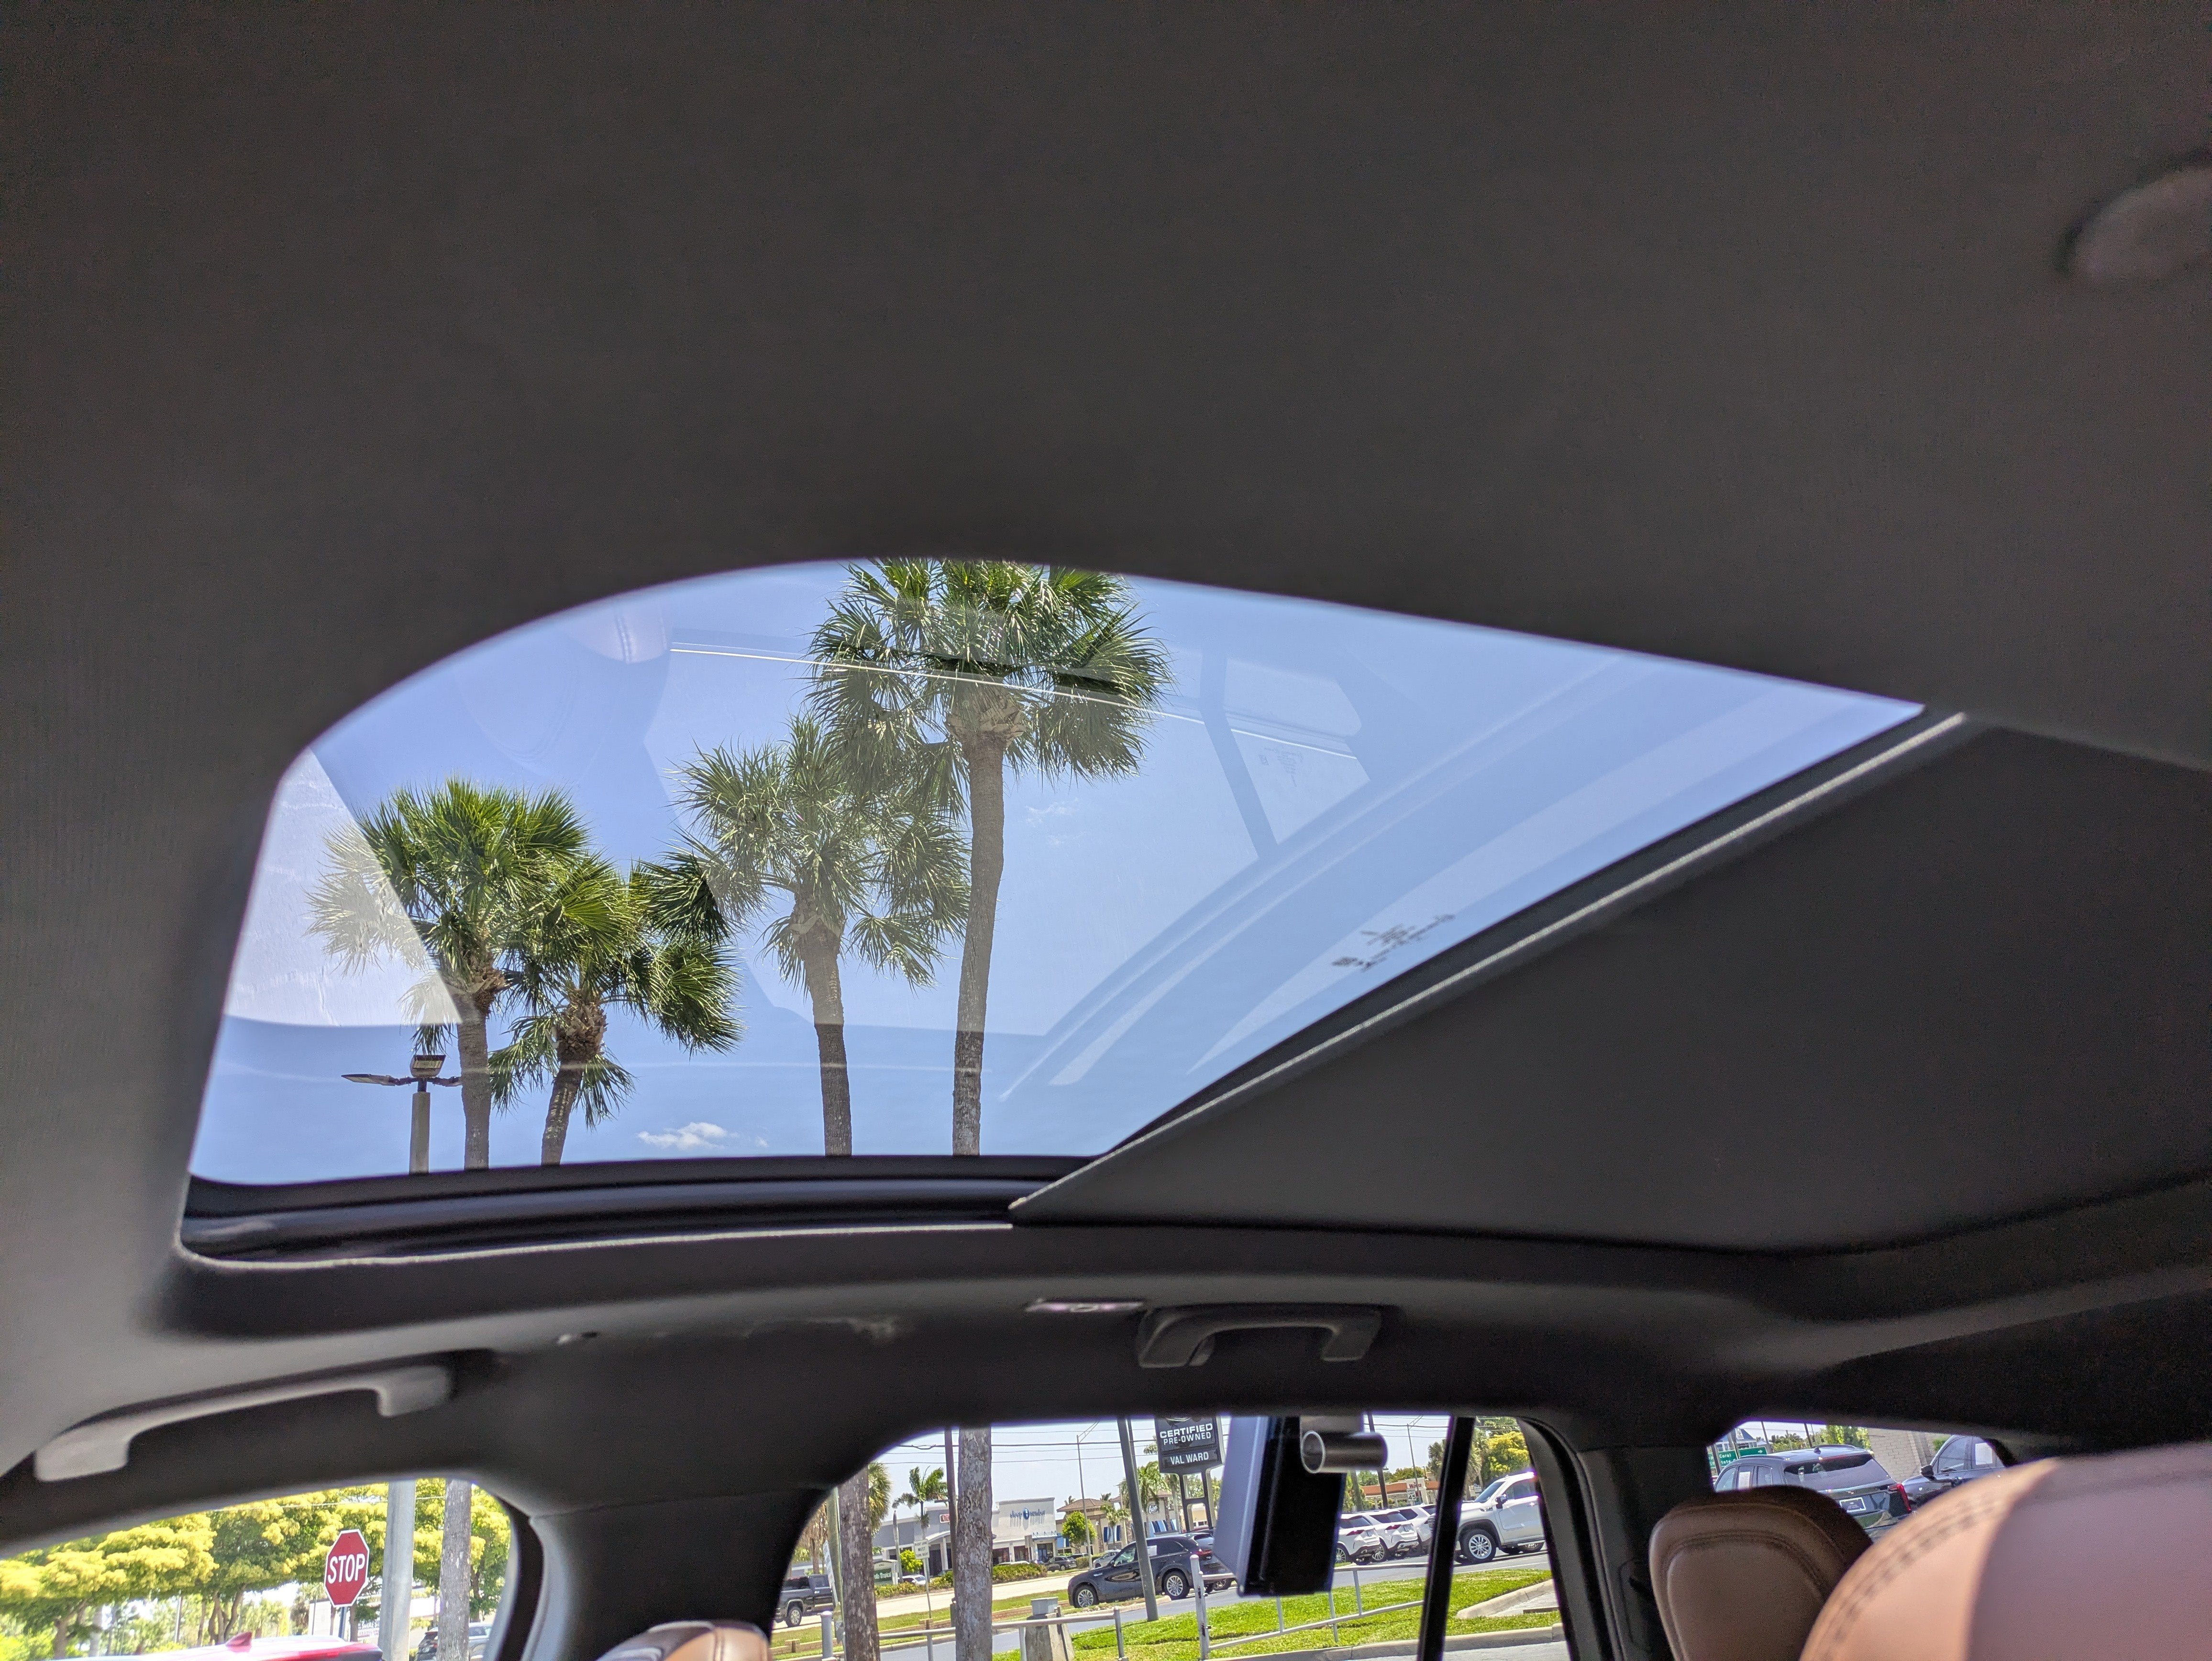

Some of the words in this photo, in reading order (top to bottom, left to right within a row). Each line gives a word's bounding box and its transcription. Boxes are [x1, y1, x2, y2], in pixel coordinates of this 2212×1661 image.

[1160, 1423, 1213, 1439] CERTIFIED
[1163, 1431, 1211, 1446] PRE-OWNED
[1170, 1455, 1184, 1465] VAL
[1186, 1451, 1209, 1463] WARD
[328, 1553, 365, 1584] STOP
